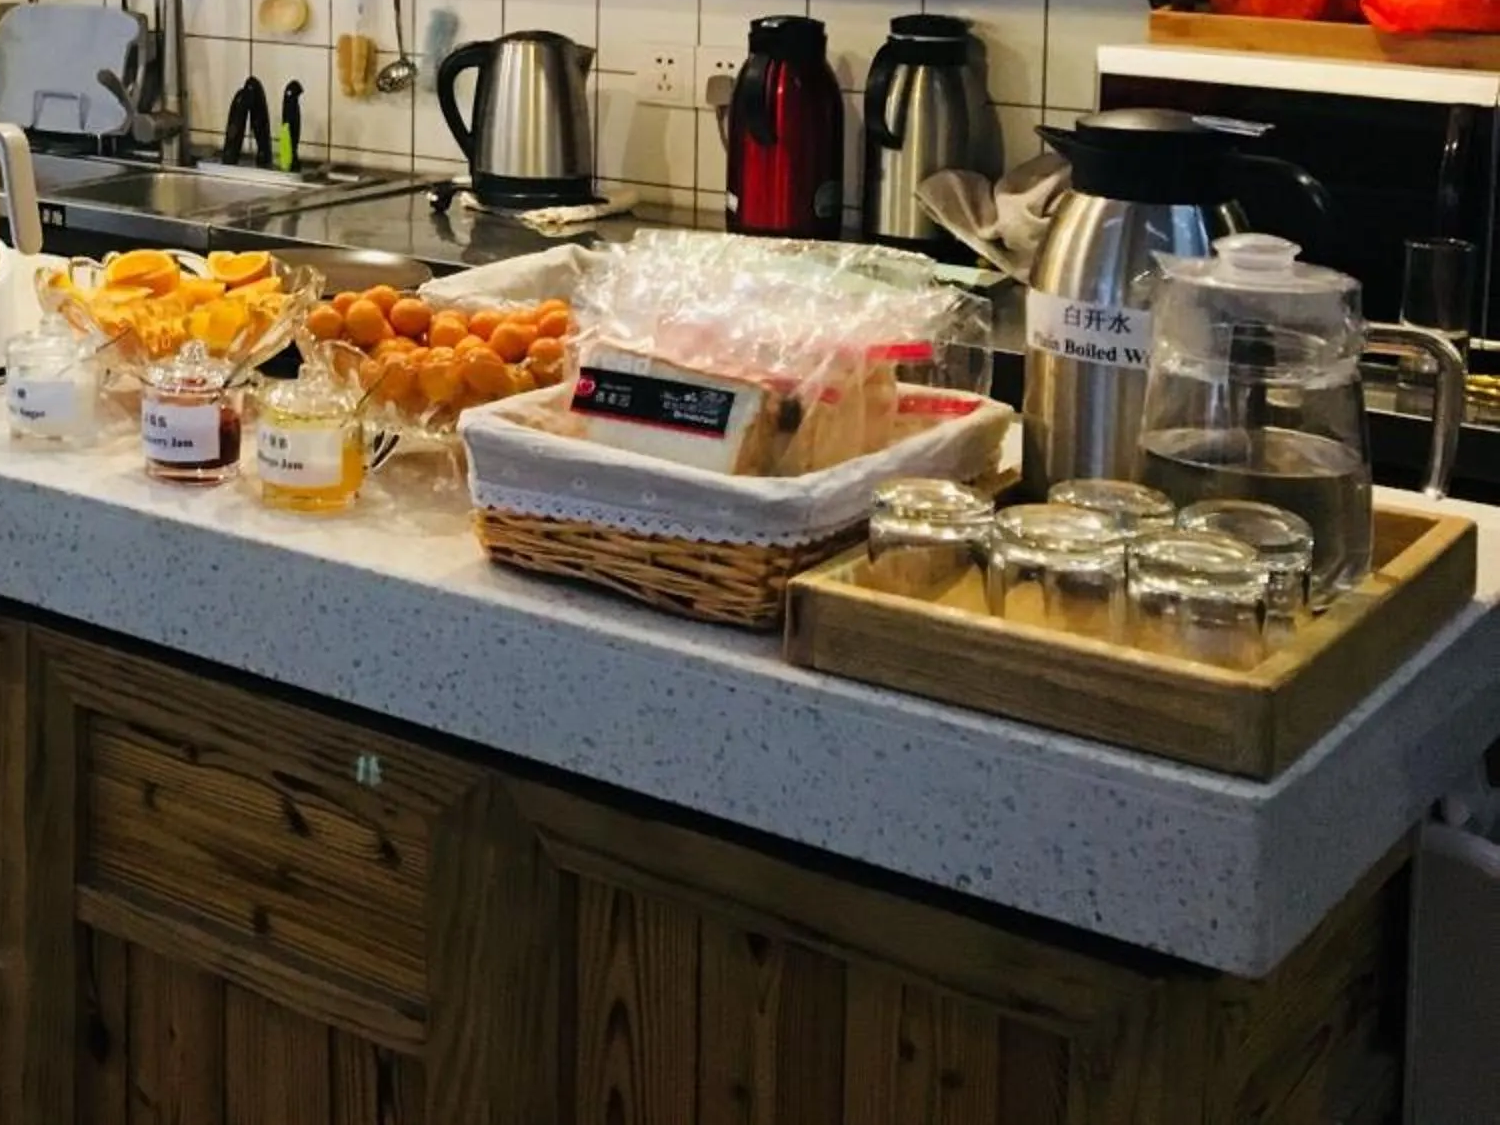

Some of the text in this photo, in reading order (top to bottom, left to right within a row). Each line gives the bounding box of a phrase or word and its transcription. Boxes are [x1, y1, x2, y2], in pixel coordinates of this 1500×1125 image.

[1064, 304, 1132, 335] 白开水
[1064, 337, 1117, 363] Boiled
[171, 436, 194, 448] Jam
[281, 458, 304, 471] Jam
